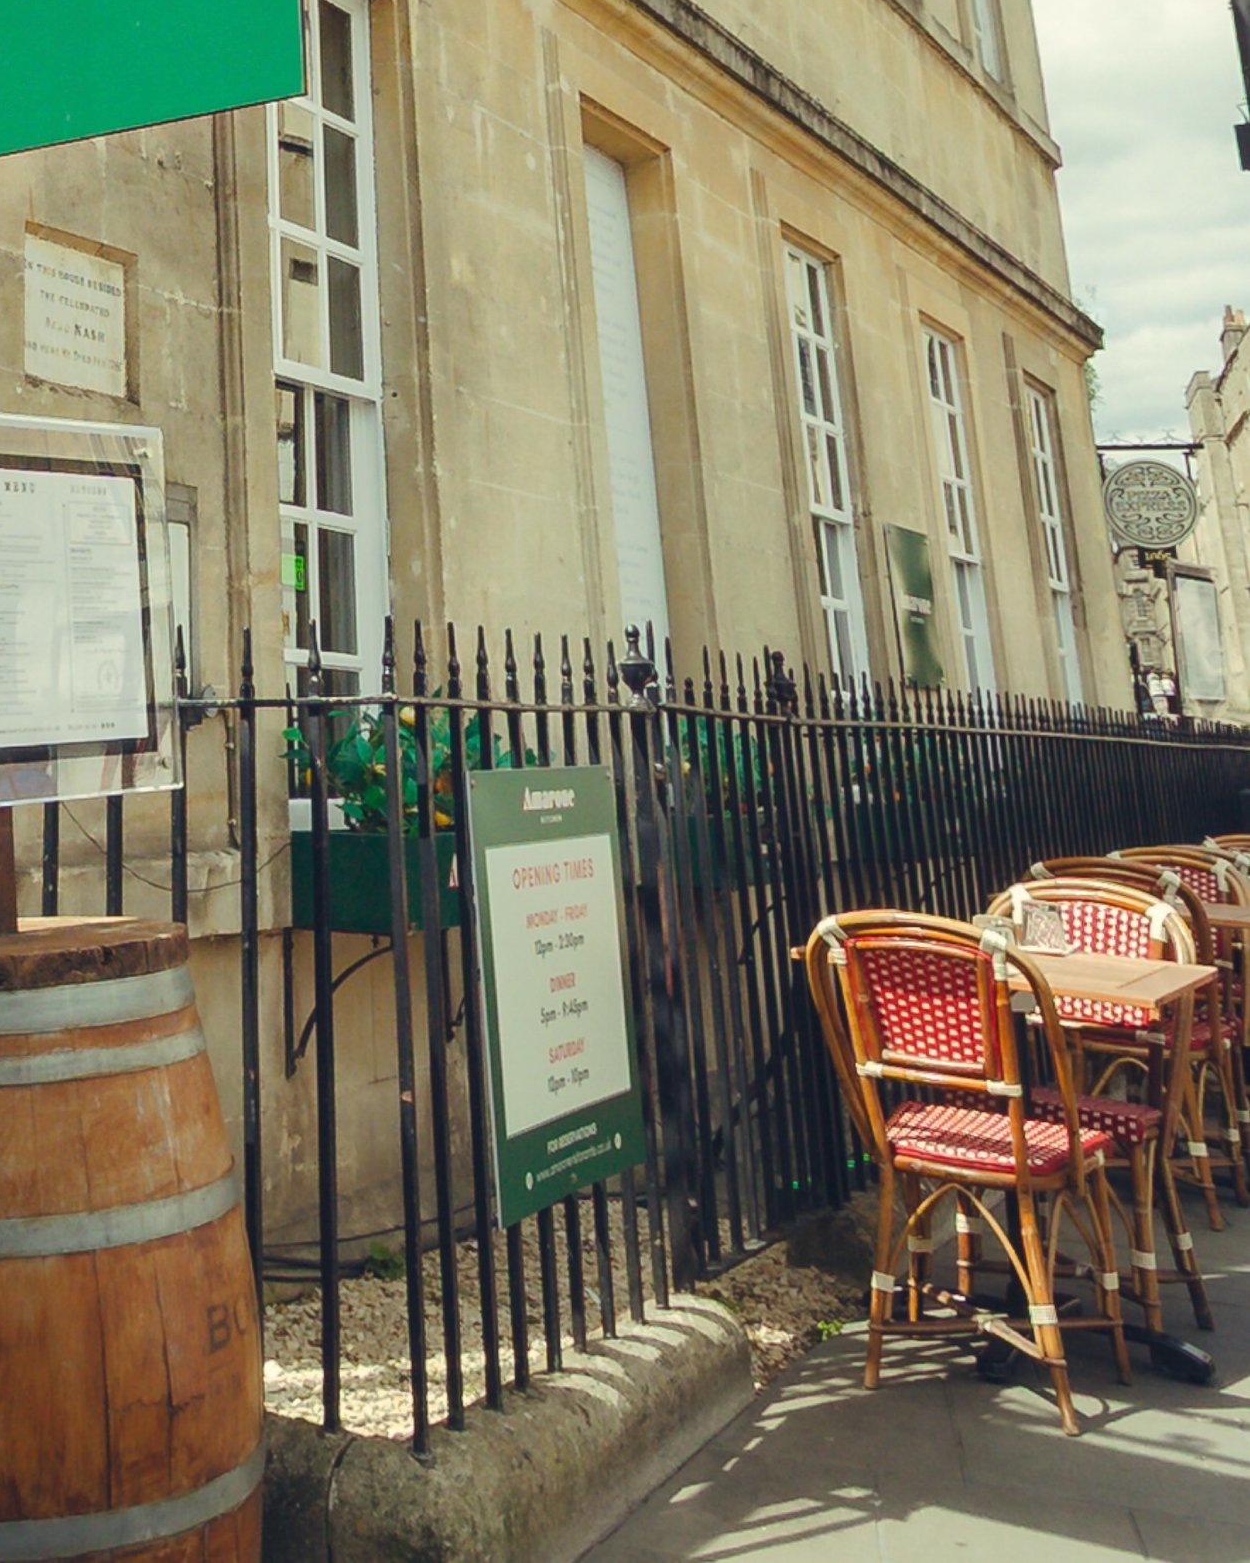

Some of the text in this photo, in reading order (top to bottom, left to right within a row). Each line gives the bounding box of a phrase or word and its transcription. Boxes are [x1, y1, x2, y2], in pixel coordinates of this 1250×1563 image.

[74, 323, 105, 343] NASH
[1115, 500, 1187, 512] EXPRESS
[1126, 491, 1171, 501] PIZZA
[522, 786, 575, 811] Amarone
[513, 857, 594, 890] OPENING TIMES
[526, 909, 558, 929] MONDAY
[565, 902, 588, 921] FRIDAY
[550, 972, 575, 993] DINNER
[548, 1038, 585, 1064] SATURDAY
